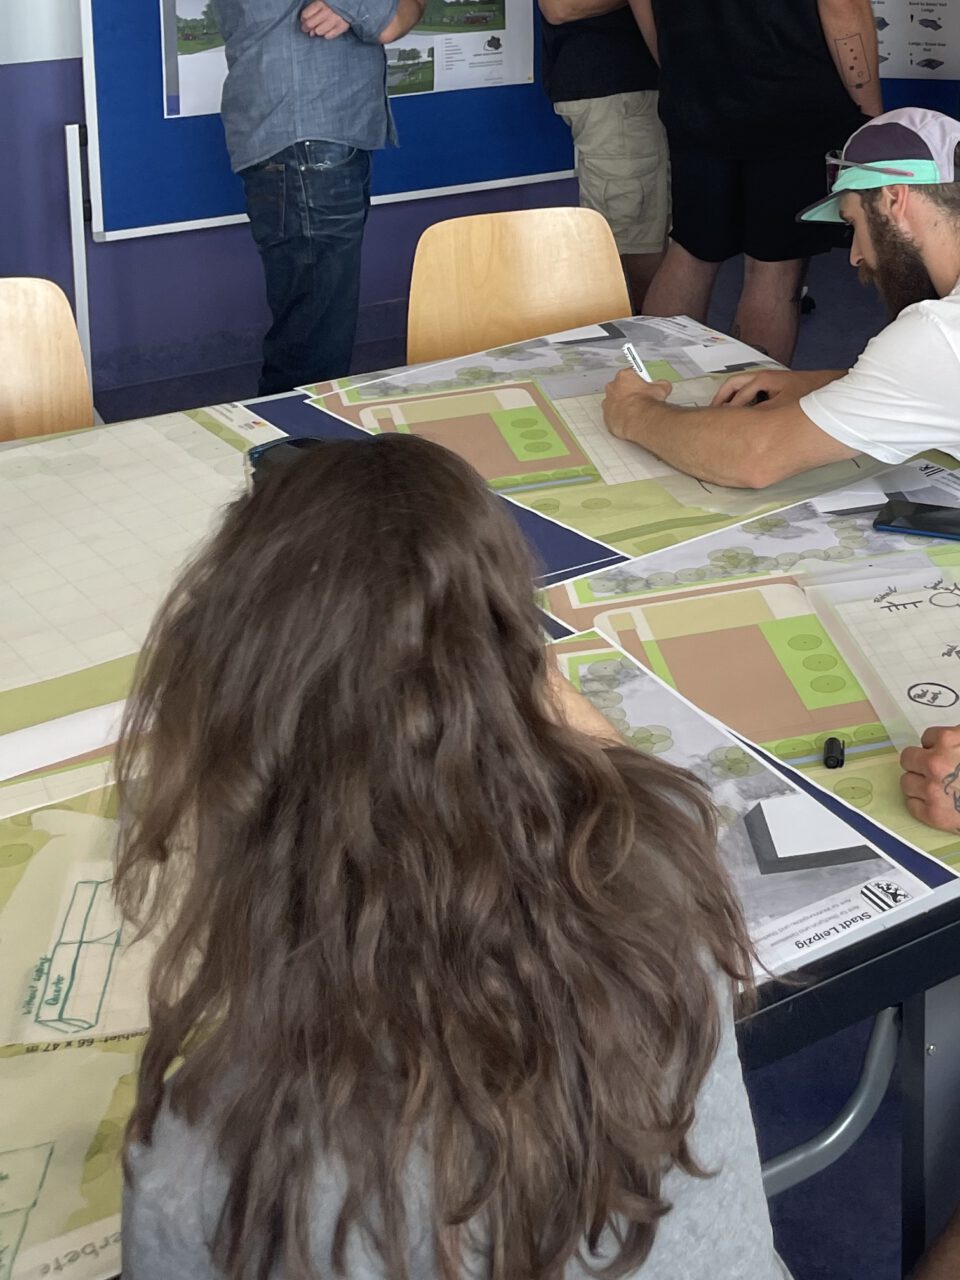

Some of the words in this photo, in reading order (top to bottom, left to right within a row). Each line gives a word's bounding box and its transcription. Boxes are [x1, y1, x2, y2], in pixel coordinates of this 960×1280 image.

[840, 911, 872, 930] Stadt
[794, 926, 840, 950] Leipzig
[43, 1042, 62, 1052] 47
[64, 1039, 73, 1048] x
[77, 1037, 94, 1048] 66
[26, 1044, 40, 1054] m
